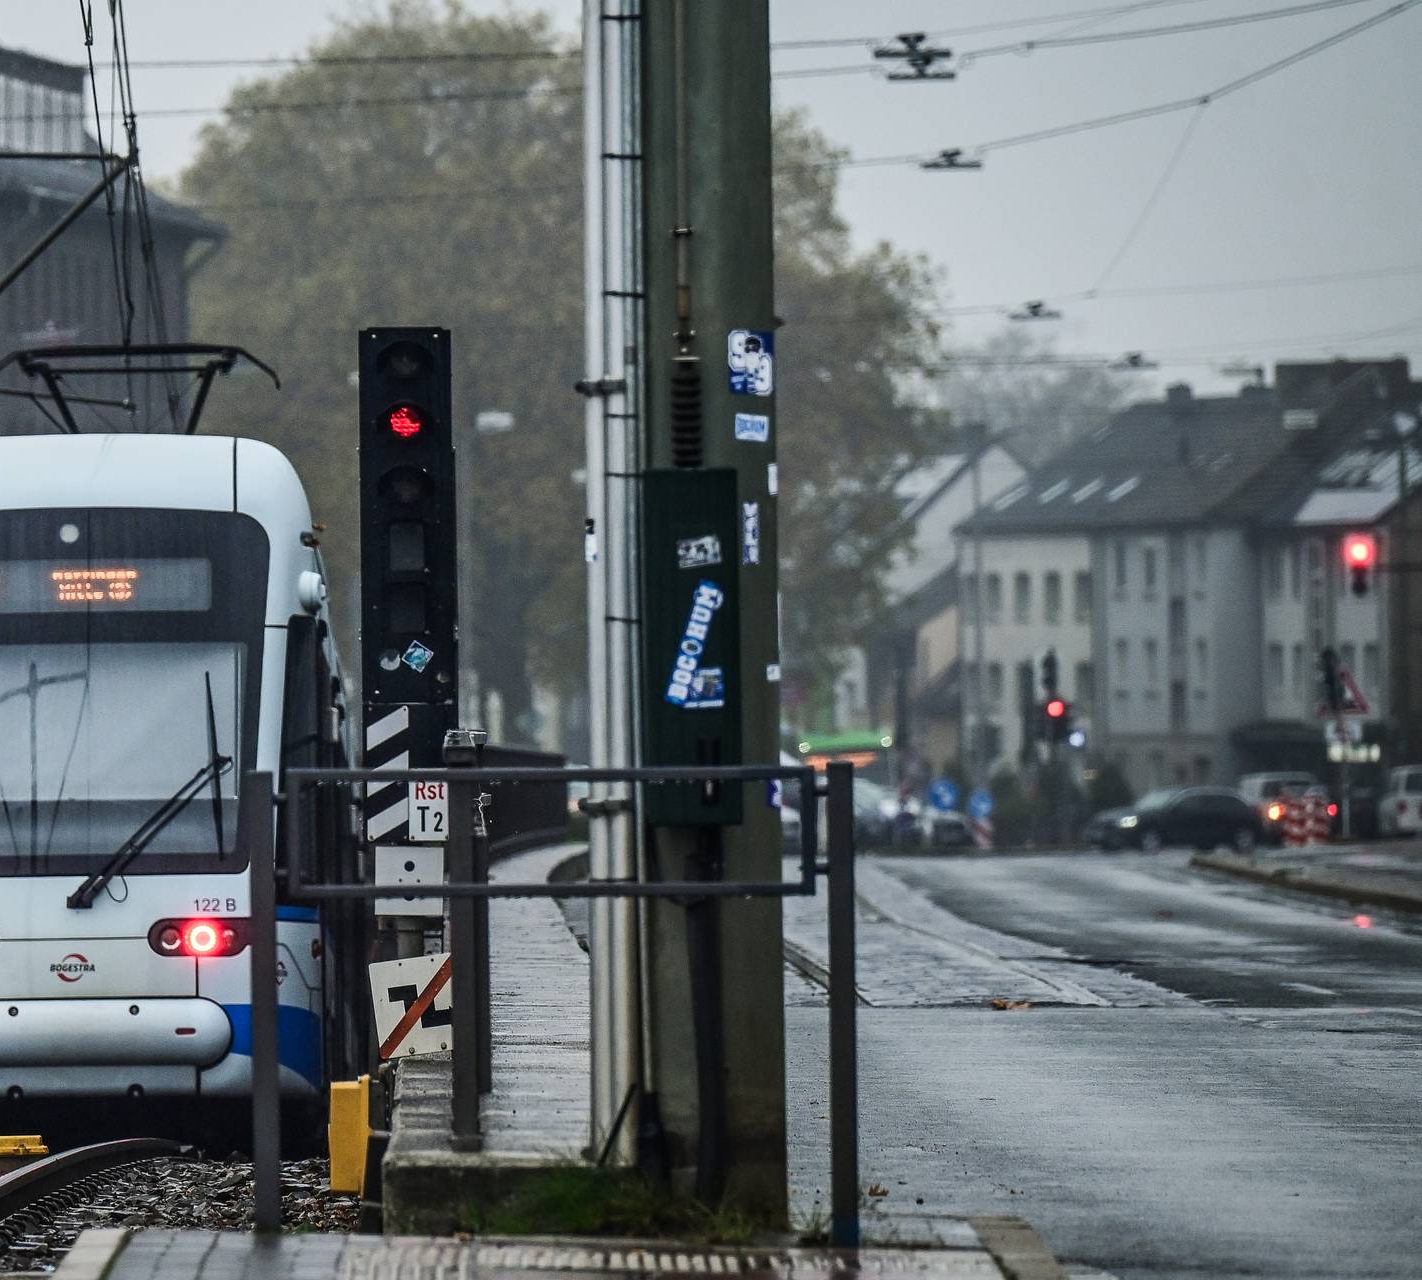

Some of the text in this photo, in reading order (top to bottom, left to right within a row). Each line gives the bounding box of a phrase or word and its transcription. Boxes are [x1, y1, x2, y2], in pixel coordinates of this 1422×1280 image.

[414, 780, 445, 800] Rst
[193, 898, 237, 912] 122 B
[49, 963, 97, 973] BOGESTRA
